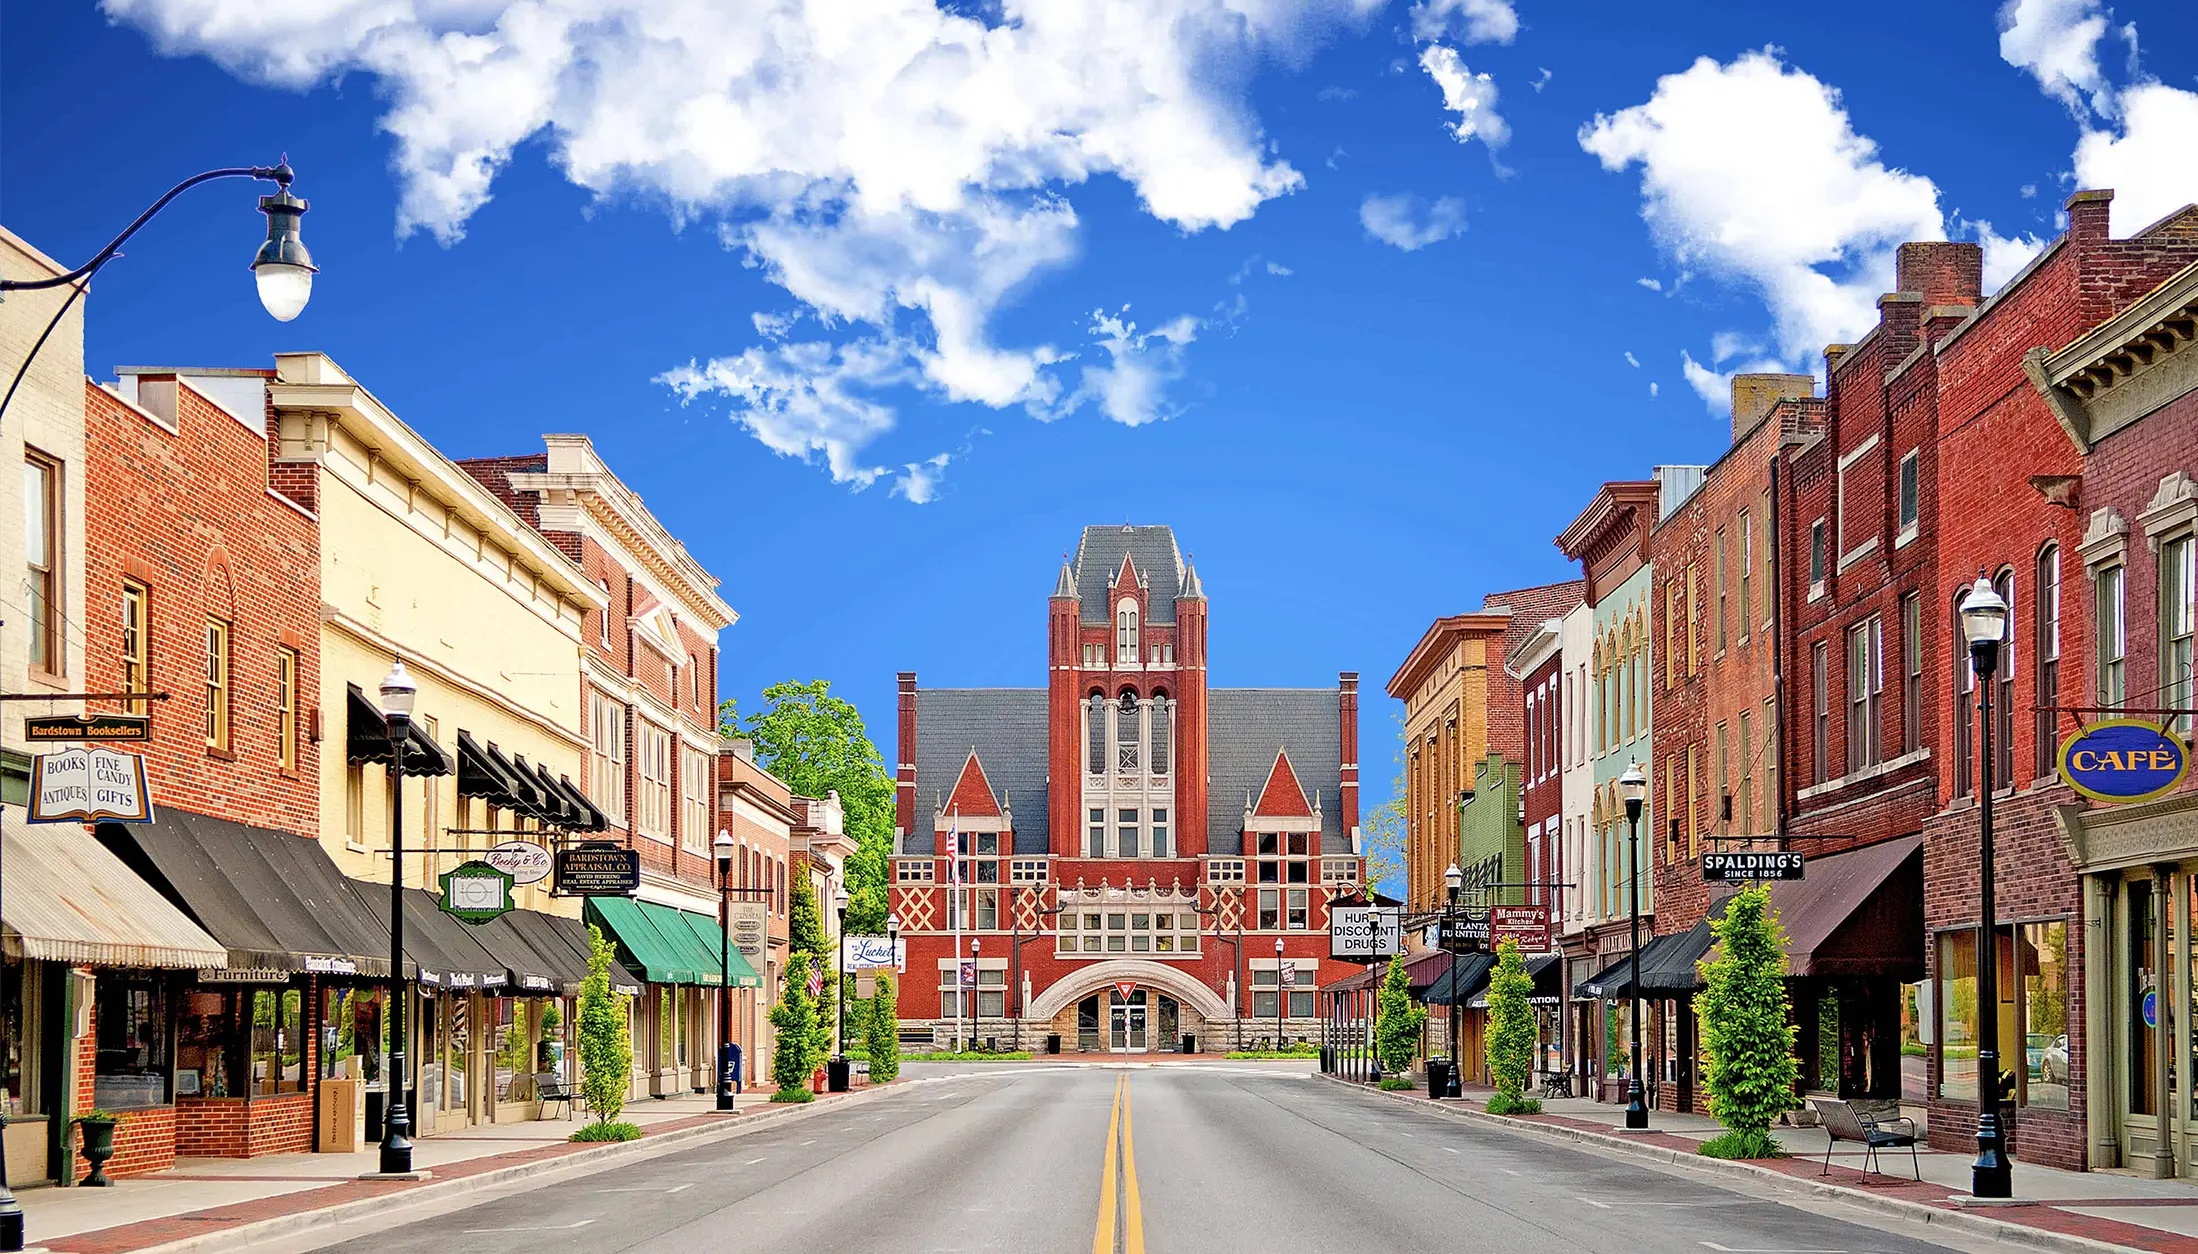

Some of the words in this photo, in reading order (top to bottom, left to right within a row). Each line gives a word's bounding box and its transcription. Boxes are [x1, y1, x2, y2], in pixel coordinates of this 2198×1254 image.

[32, 726, 82, 736] Bardstown
[87, 726, 141, 736] Booksellers
[2072, 744, 2176, 772] CAFÉ
[47, 757, 86, 774] BOOKS
[95, 757, 121, 771] FINE
[97, 769, 132, 786] CANDY
[43, 786, 87, 804] ANTIQUES
[97, 789, 133, 807] GIFTS
[490, 853, 521, 868] Becky
[523, 855, 531, 865] &
[569, 854, 627, 862] BARDSTOWN
[1705, 853, 1801, 869] SPALDING'S
[564, 863, 614, 871] APPRAISAL
[1345, 913, 1383, 923] HURT
[1496, 909, 1545, 920] Mammy's
[1334, 926, 1396, 936] DISCOUNT
[1455, 922, 1490, 930] PLANTA
[1345, 939, 1387, 949] DRUGS
[214, 969, 284, 980] Furniture
[1525, 996, 1559, 1004] TATION
